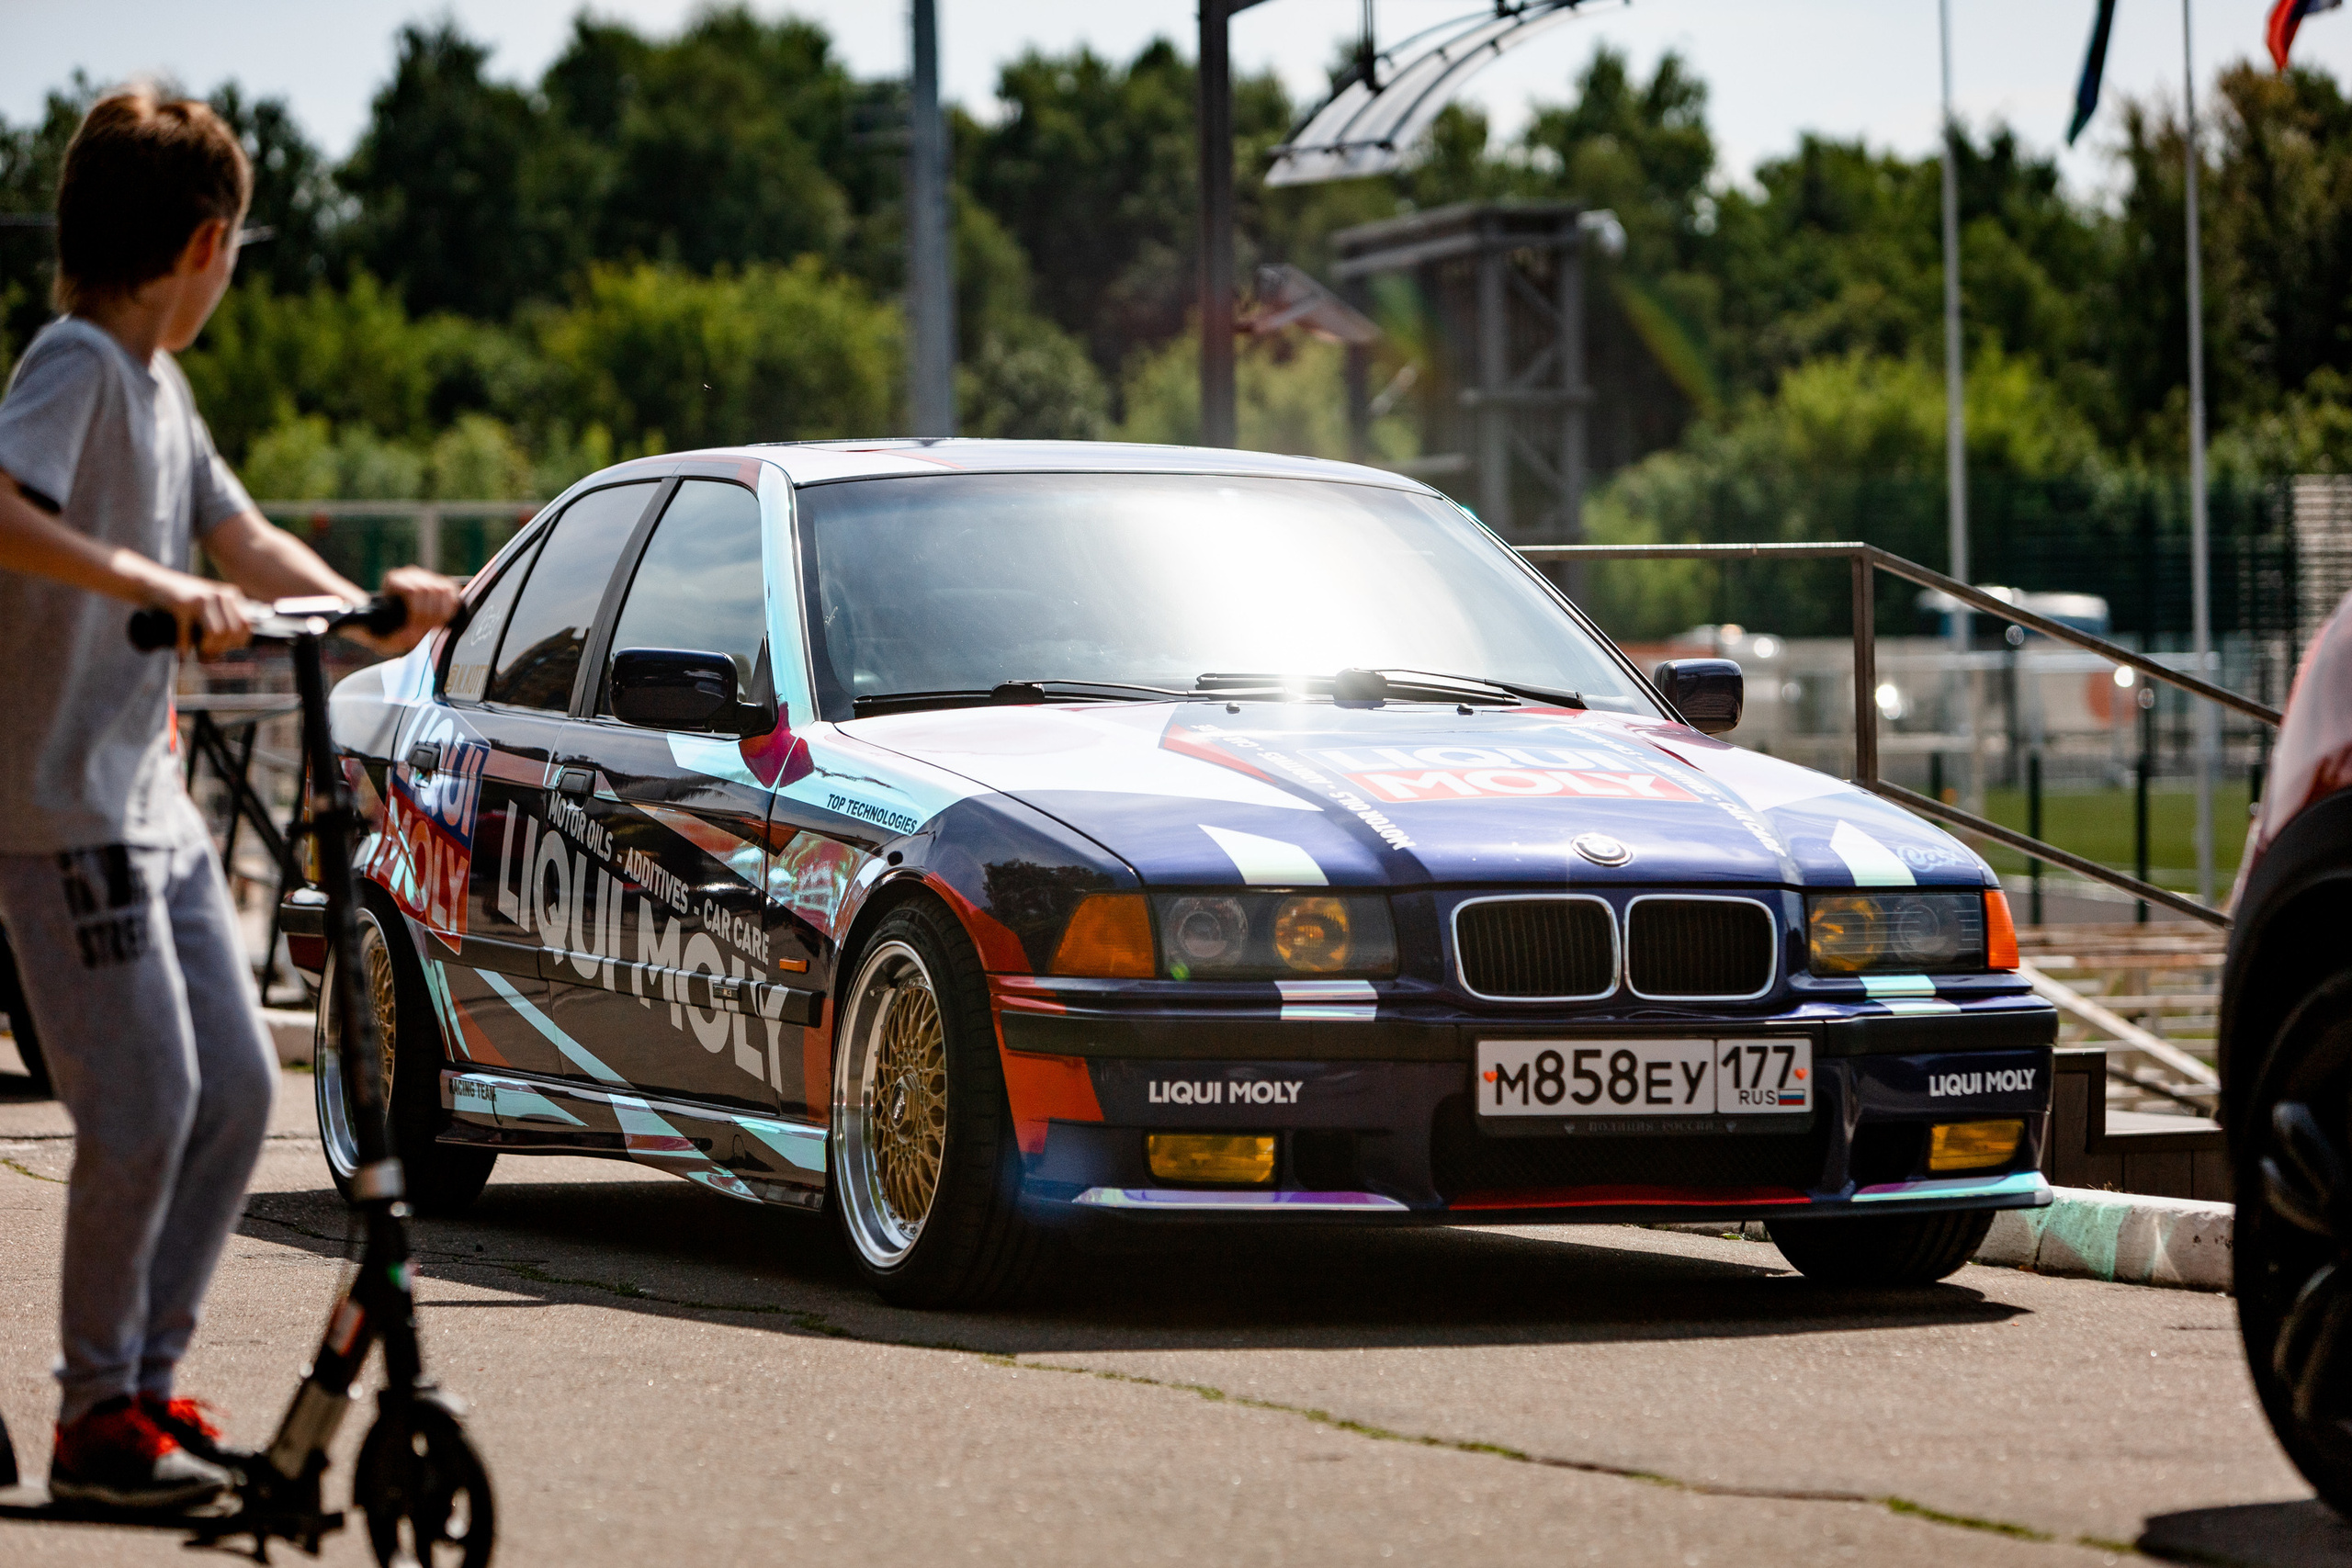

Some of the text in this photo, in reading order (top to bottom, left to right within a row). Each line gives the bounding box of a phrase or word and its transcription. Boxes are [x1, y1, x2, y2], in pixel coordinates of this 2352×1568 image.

[1317, 747, 1634, 772] LIQUI
[1363, 770, 1667, 799] MOLY
[827, 794, 918, 835] TOP TECHNOLOGIES
[1329, 791, 1373, 813] OILS
[1357, 812, 1417, 851] MOTOR
[548, 793, 587, 845] MOTOR
[586, 818, 614, 863] OILS
[624, 846, 689, 915] ADDITIVES
[703, 897, 731, 943] CAR
[733, 917, 770, 966] CARE
[497, 799, 791, 1095] LIQUI MOLY
[1721, 1045, 1796, 1089] 177
[448, 1077, 498, 1102] RACING TEAM
[1148, 1080, 1304, 1105] LIQUI MOLY
[1738, 1090, 1776, 1105] RUS
[1929, 1068, 2037, 1098] LIQUI MOLY
